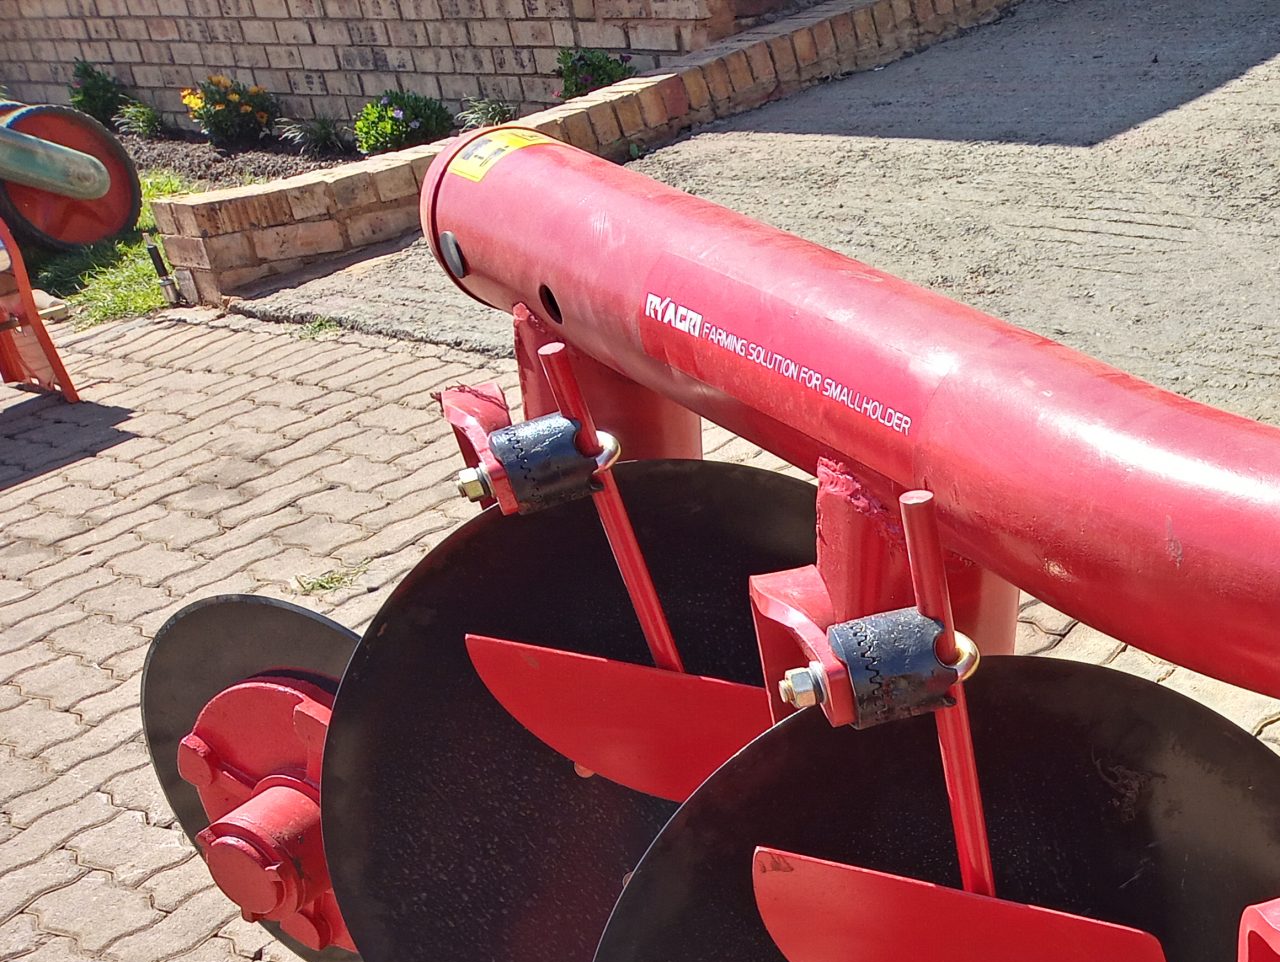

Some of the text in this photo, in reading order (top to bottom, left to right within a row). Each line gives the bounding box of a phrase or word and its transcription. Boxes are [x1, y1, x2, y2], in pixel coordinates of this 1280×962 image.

[701, 323, 747, 356] FARMING
[746, 344, 799, 380] SOLUTION
[798, 367, 821, 391] FOR
[823, 378, 912, 436] SMALLHOLDER
